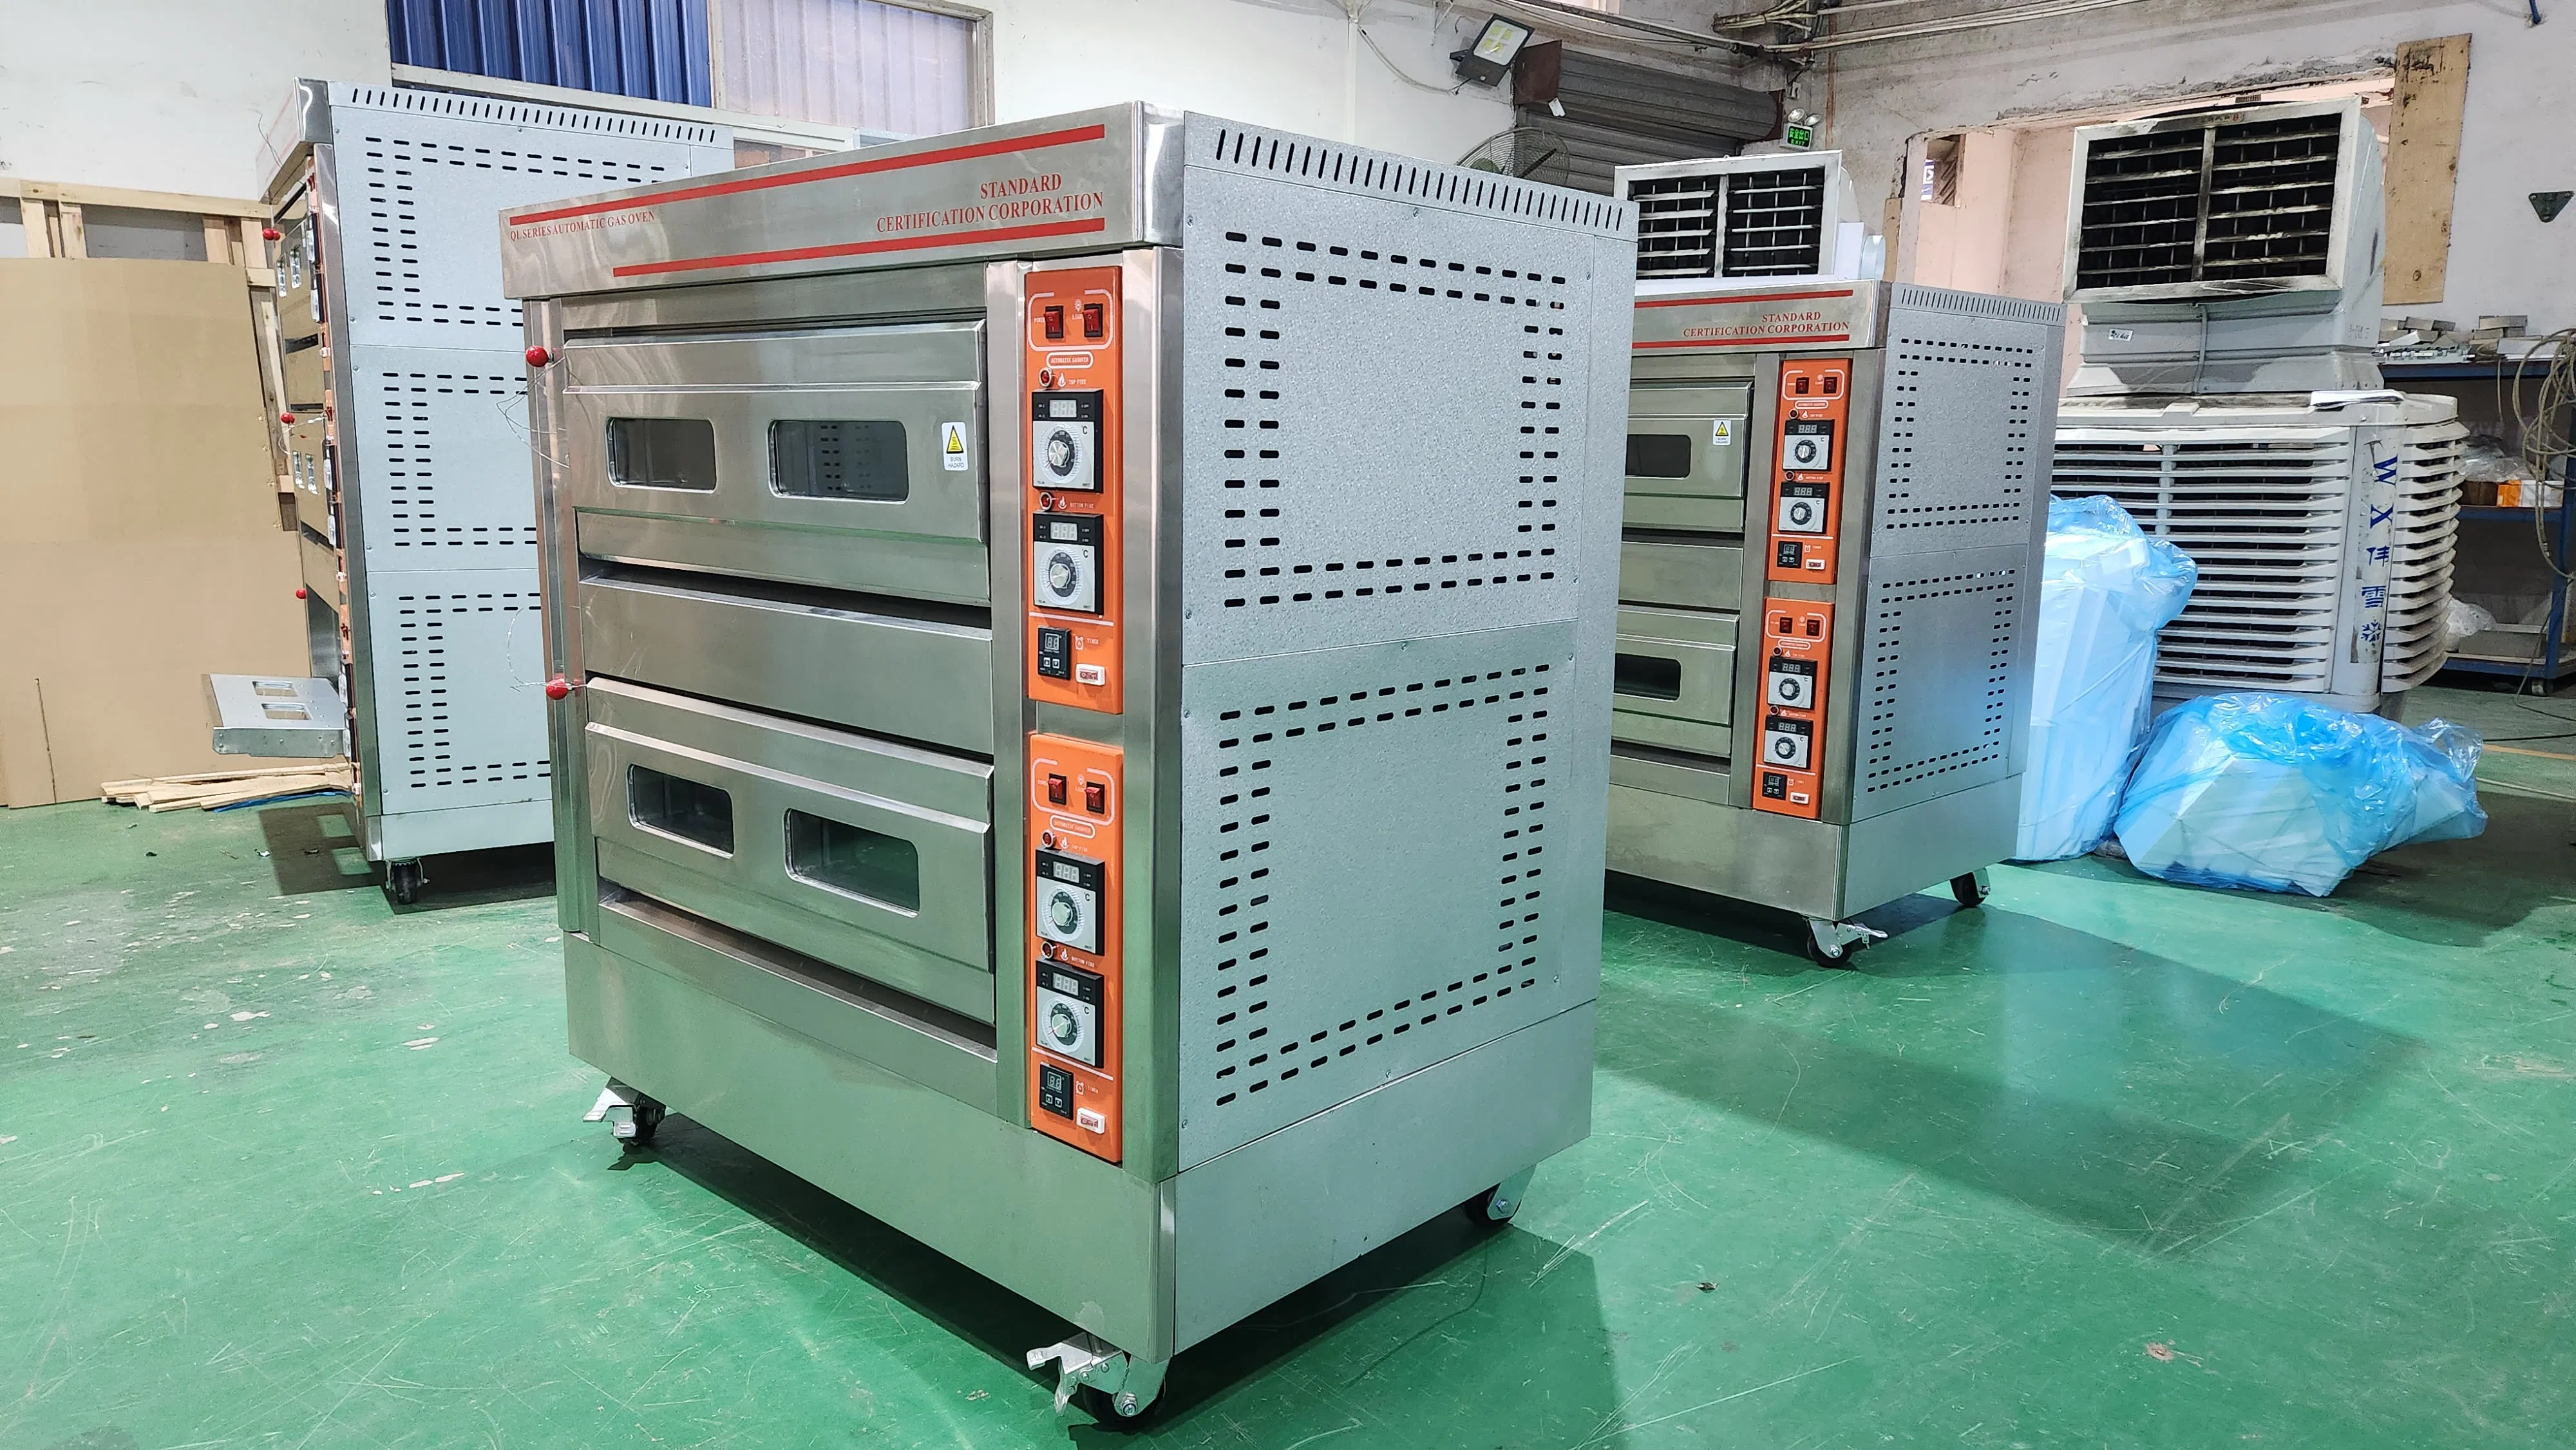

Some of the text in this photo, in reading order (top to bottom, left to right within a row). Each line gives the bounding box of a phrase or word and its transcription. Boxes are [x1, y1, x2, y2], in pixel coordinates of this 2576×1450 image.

[980, 173, 1062, 200] STANDARD
[876, 191, 1104, 232] CERTIFICATION CORPORATION
[510, 210, 656, 242] QL SERIES AUTOMATIC GAS OVEN
[1683, 321, 1850, 337] CERTIFICATION CORPORATION
[1762, 311, 1821, 323] STANDARD
